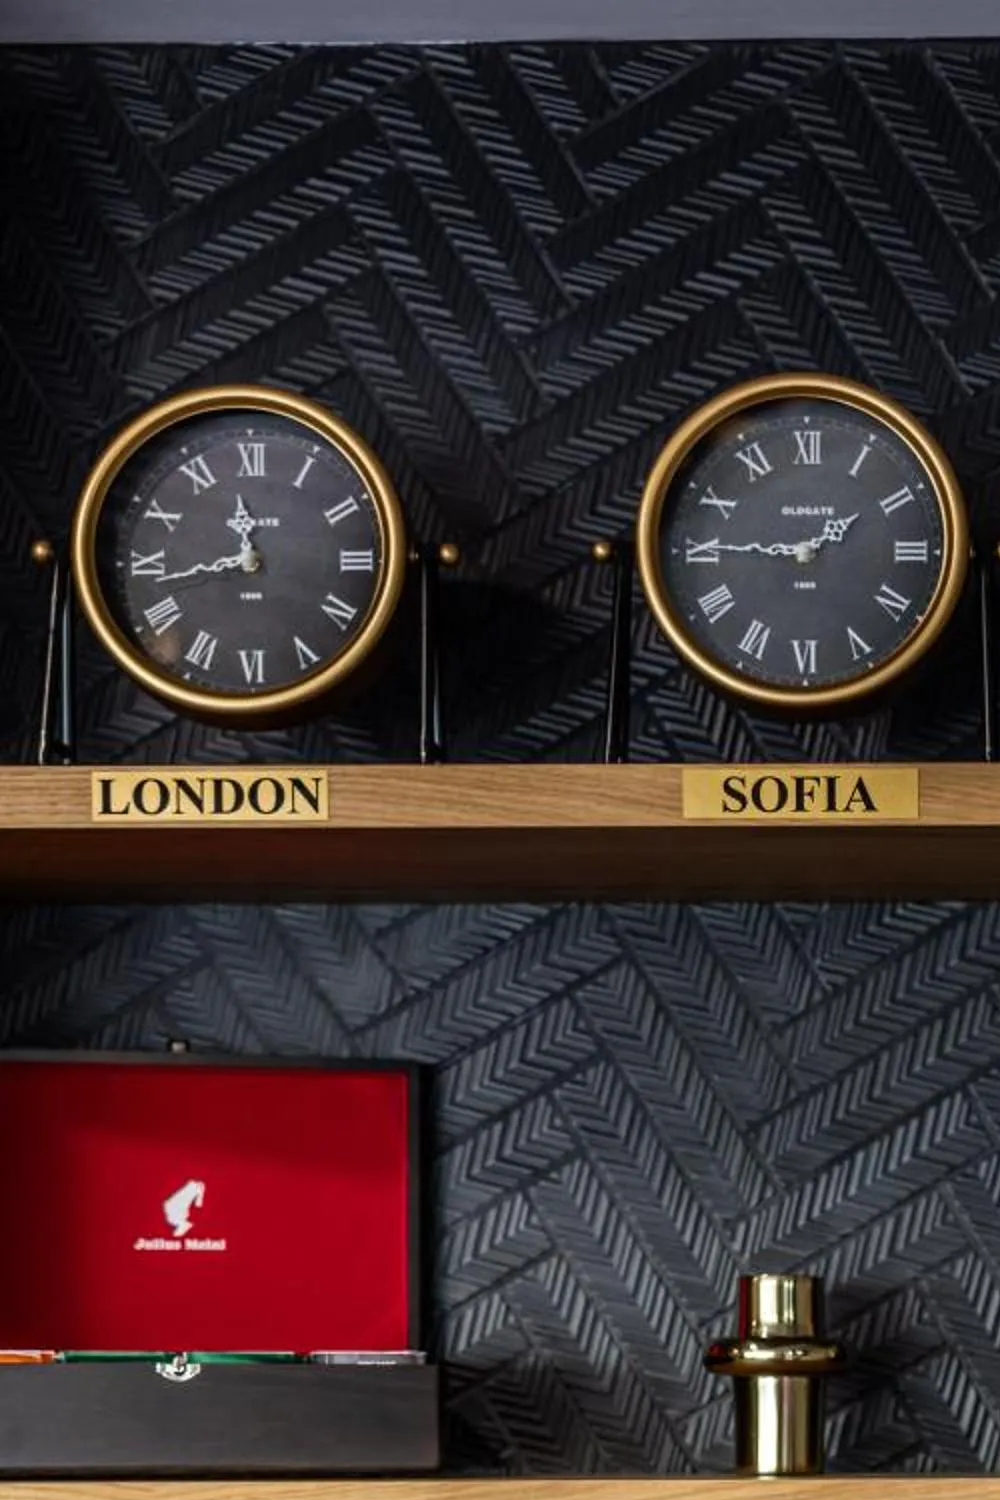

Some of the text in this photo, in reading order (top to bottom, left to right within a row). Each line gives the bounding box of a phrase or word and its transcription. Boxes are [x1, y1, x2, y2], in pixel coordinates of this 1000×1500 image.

[237, 443, 266, 476] XII
[735, 442, 772, 482] XI
[792, 431, 821, 464] XII
[849, 445, 871, 478] I
[179, 455, 218, 495] XI
[293, 456, 316, 489] I
[144, 499, 182, 532] X
[324, 496, 359, 525] II
[700, 486, 736, 519] X
[781, 506, 835, 515] OLDGATE
[879, 486, 914, 515] II
[340, 549, 372, 572] III
[895, 541, 928, 562] III
[144, 596, 183, 636] VIII
[321, 592, 358, 631] IV
[698, 584, 736, 624] VIII
[874, 584, 911, 622] IV
[184, 631, 218, 670] VII
[293, 636, 319, 669] V
[738, 620, 771, 660] VII
[791, 640, 816, 673] VI
[848, 627, 872, 659] V
[239, 651, 264, 683] VI
[97, 777, 323, 815] LONDON
[721, 775, 878, 813] SOFIA
